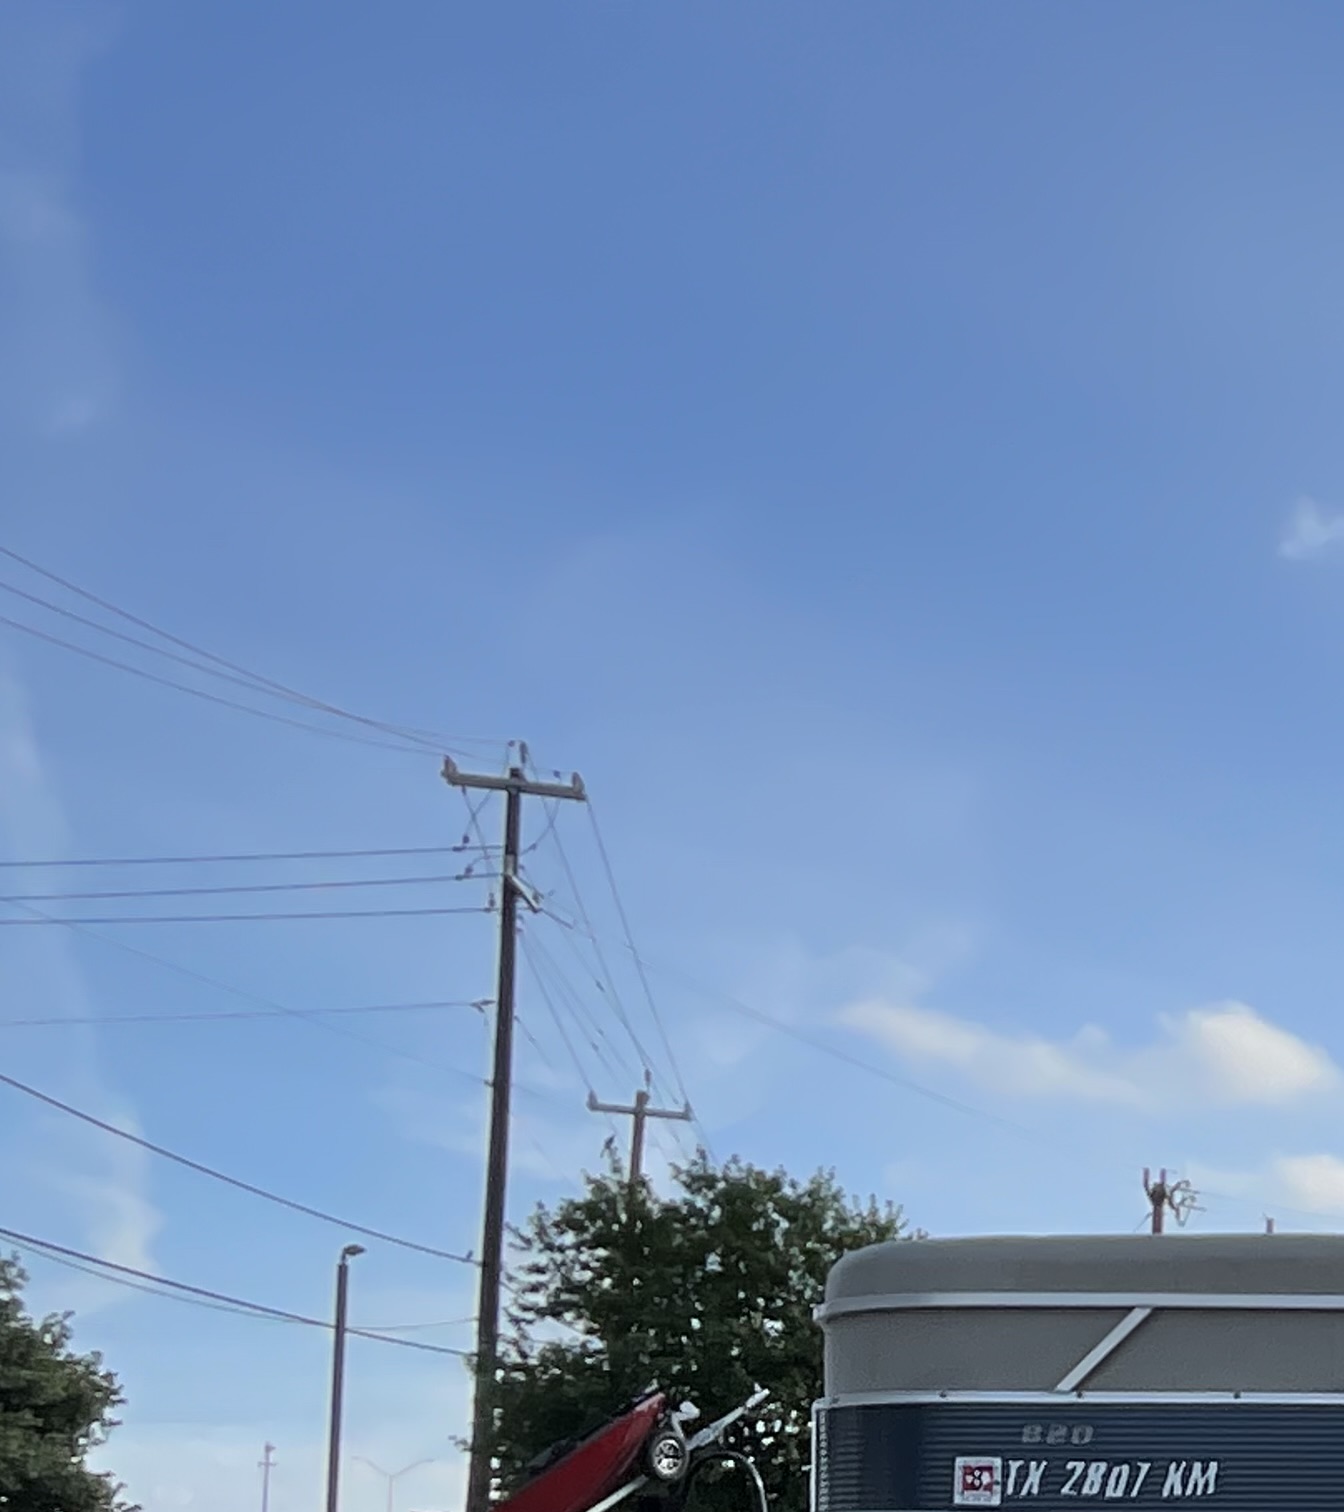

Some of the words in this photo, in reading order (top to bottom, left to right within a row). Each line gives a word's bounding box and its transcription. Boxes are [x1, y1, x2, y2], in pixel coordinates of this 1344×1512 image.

[1005, 1459, 1048, 1497] TX
[1060, 1460, 1151, 1498] 2807
[1161, 1460, 1218, 1498] KM
